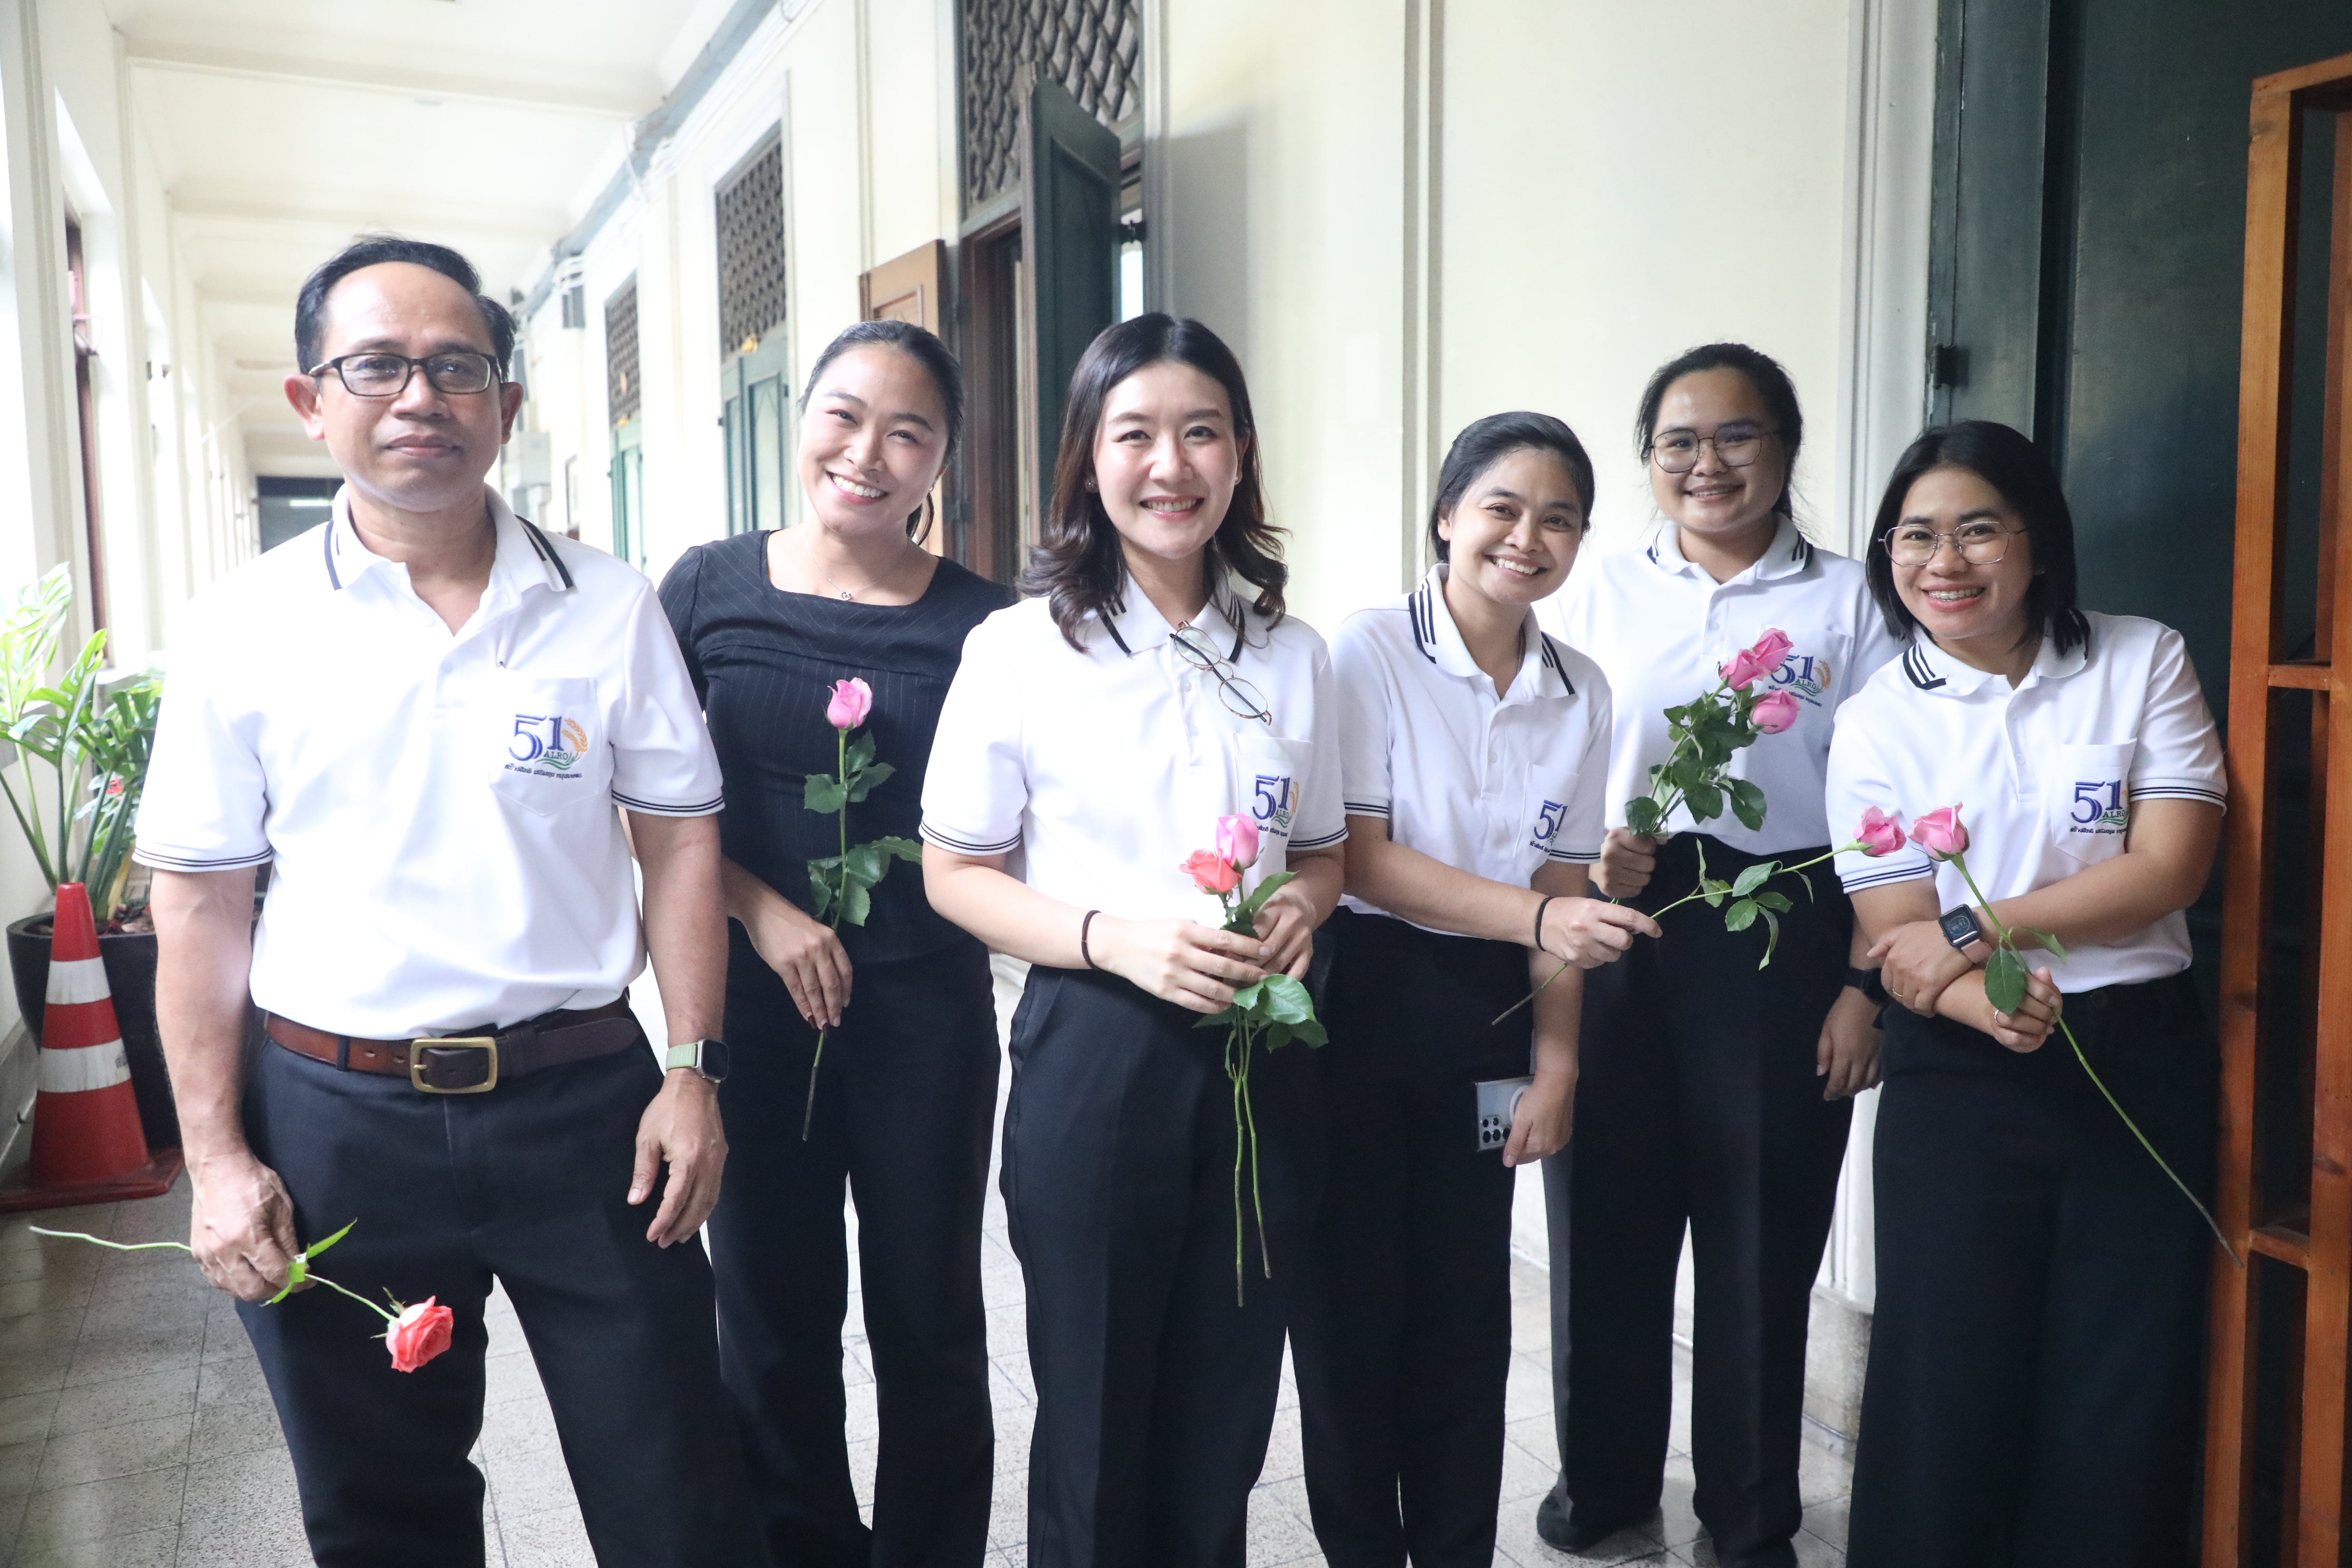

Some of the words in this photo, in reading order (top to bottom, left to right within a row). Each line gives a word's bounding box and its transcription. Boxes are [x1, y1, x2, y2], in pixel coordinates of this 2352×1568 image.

[1771, 655, 1814, 684] 51
[1796, 679, 1817, 690] ALRO
[508, 714, 564, 761] 51
[543, 751, 569, 760] ALRO
[1252, 775, 1290, 820] 51
[1276, 809, 1289, 819] ALRO
[2071, 780, 2123, 824] 51
[1534, 800, 1568, 839] 51
